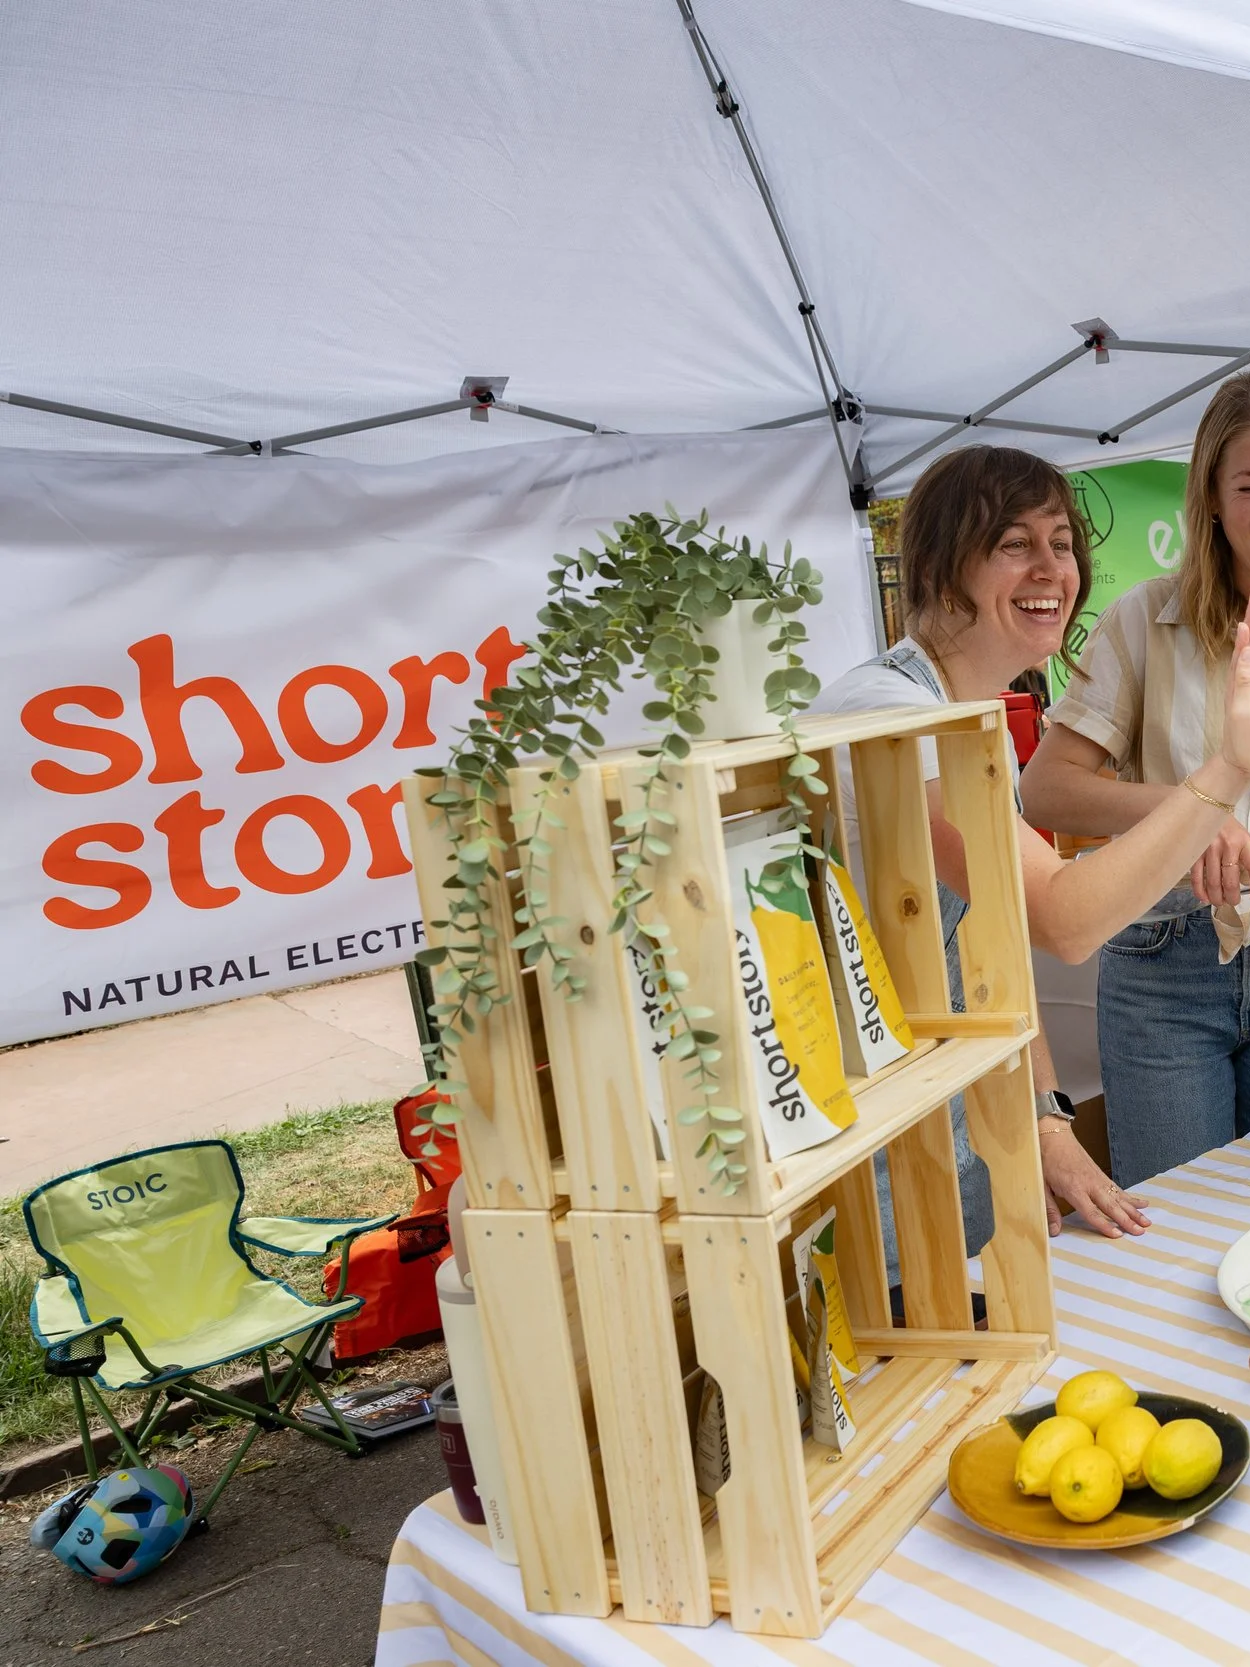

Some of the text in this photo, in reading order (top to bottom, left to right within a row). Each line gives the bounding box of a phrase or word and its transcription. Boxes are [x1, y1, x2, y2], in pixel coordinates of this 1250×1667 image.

[20, 625, 532, 794] short
[42, 780, 413, 930] stor
[63, 920, 427, 1016] NATURAL ELECTR
[849, 955, 884, 1044] short
[751, 1018, 805, 1122] short
[87, 1173, 168, 1210] STOIC
